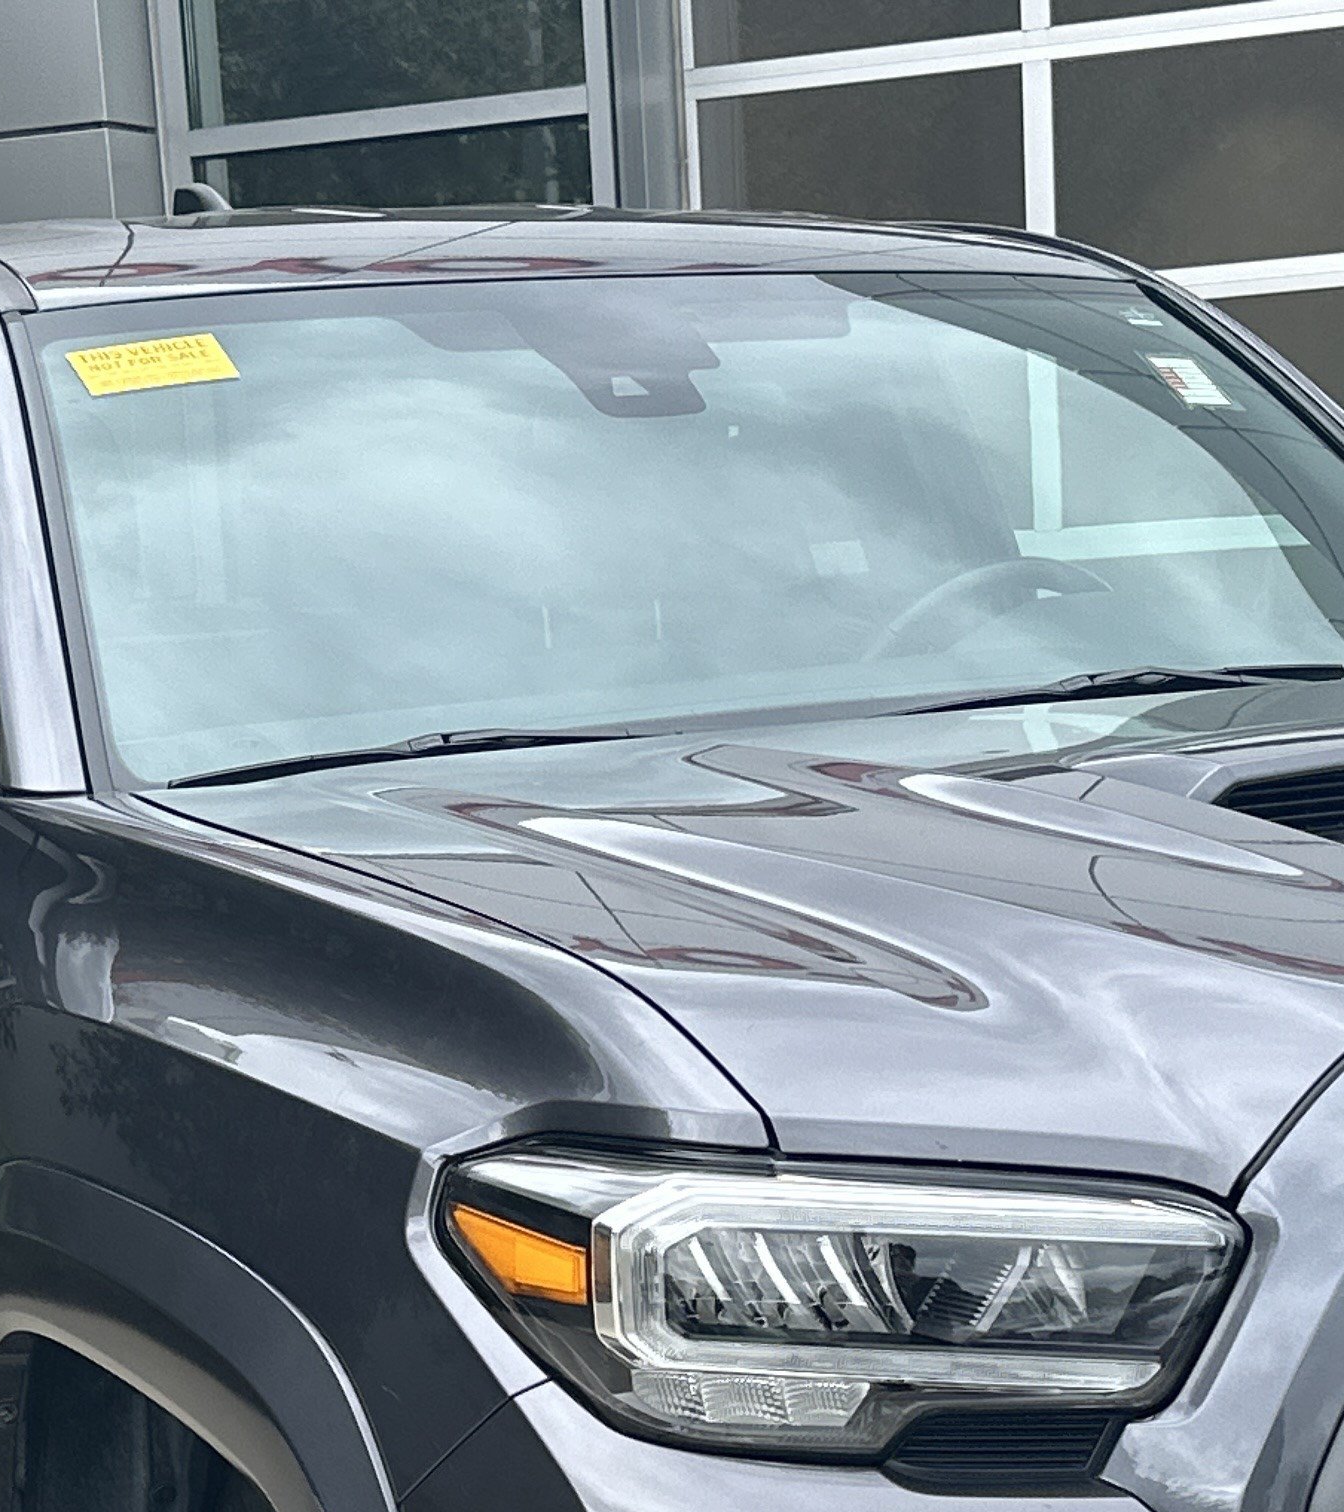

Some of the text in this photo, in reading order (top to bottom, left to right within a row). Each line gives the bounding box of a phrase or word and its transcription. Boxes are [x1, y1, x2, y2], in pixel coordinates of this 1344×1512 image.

[78, 338, 209, 364] THIS VEHICLE
[88, 350, 210, 373] NOT FOR SALE
